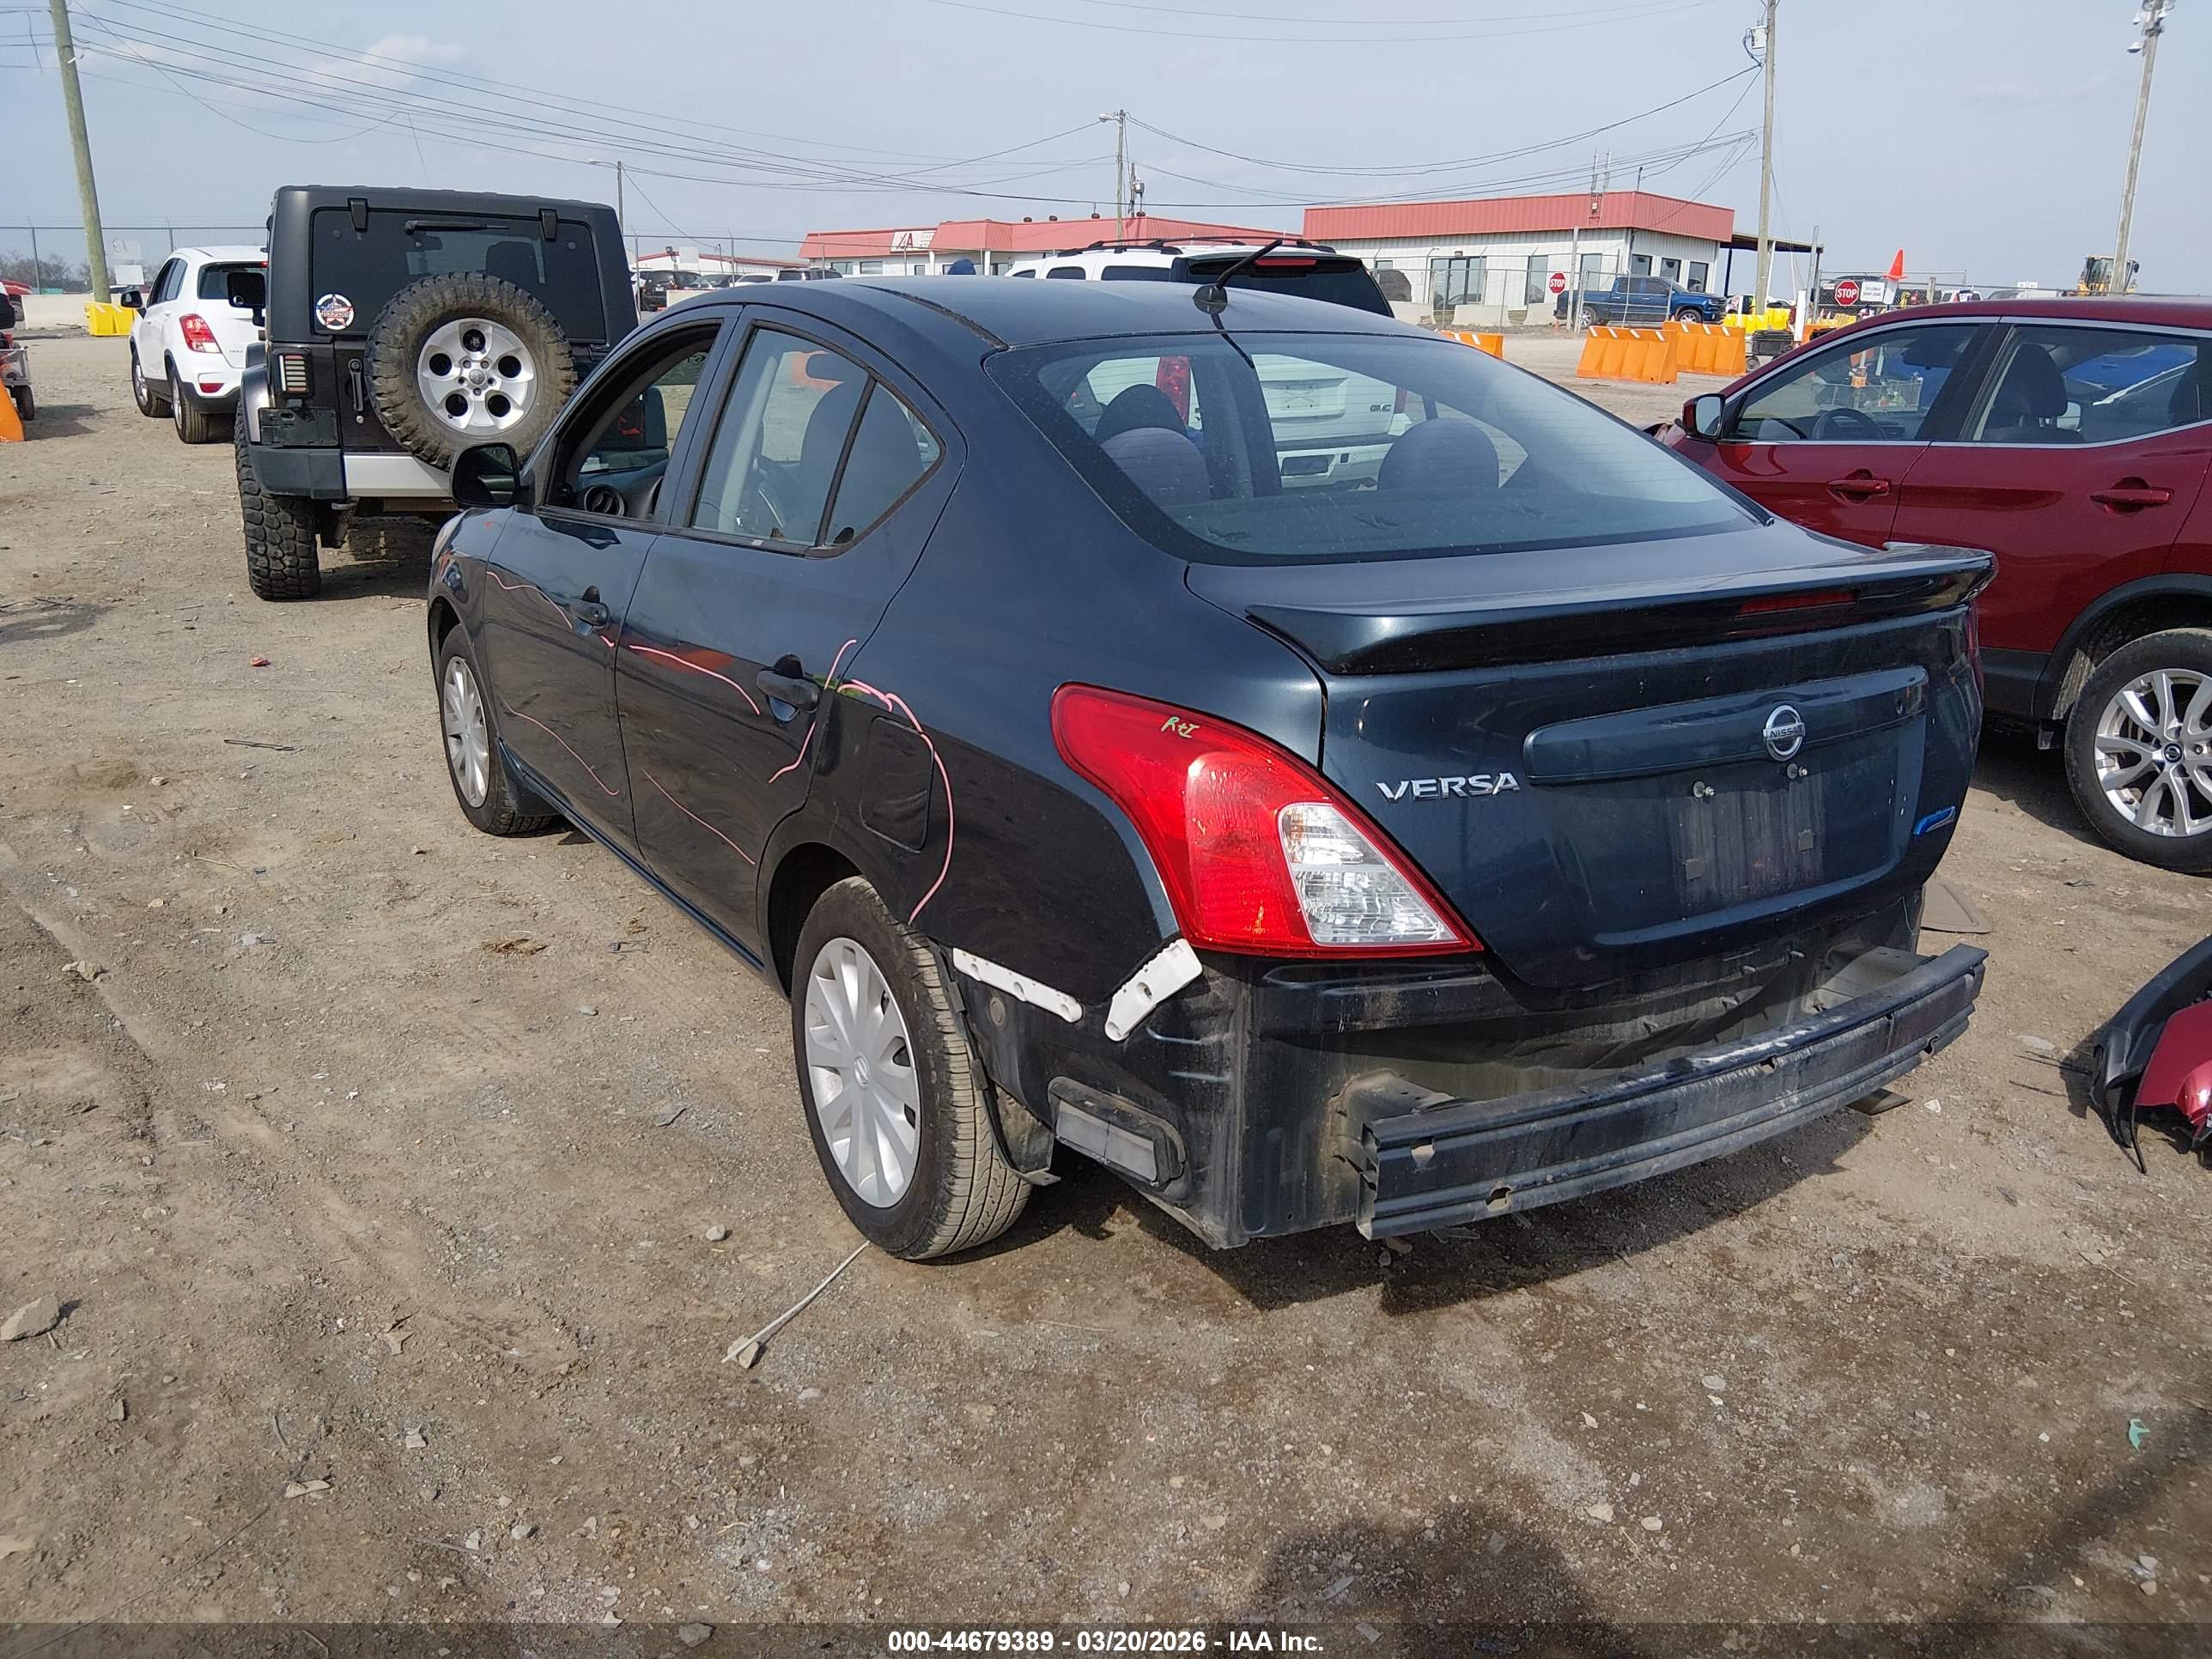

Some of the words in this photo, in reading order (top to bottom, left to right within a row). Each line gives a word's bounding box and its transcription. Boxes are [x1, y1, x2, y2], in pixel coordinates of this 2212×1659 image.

[1549, 278, 1565, 288] STOP
[1838, 288, 1857, 299] STOP
[1370, 404, 1392, 412] GMC
[1376, 772, 1521, 804] VERSA
